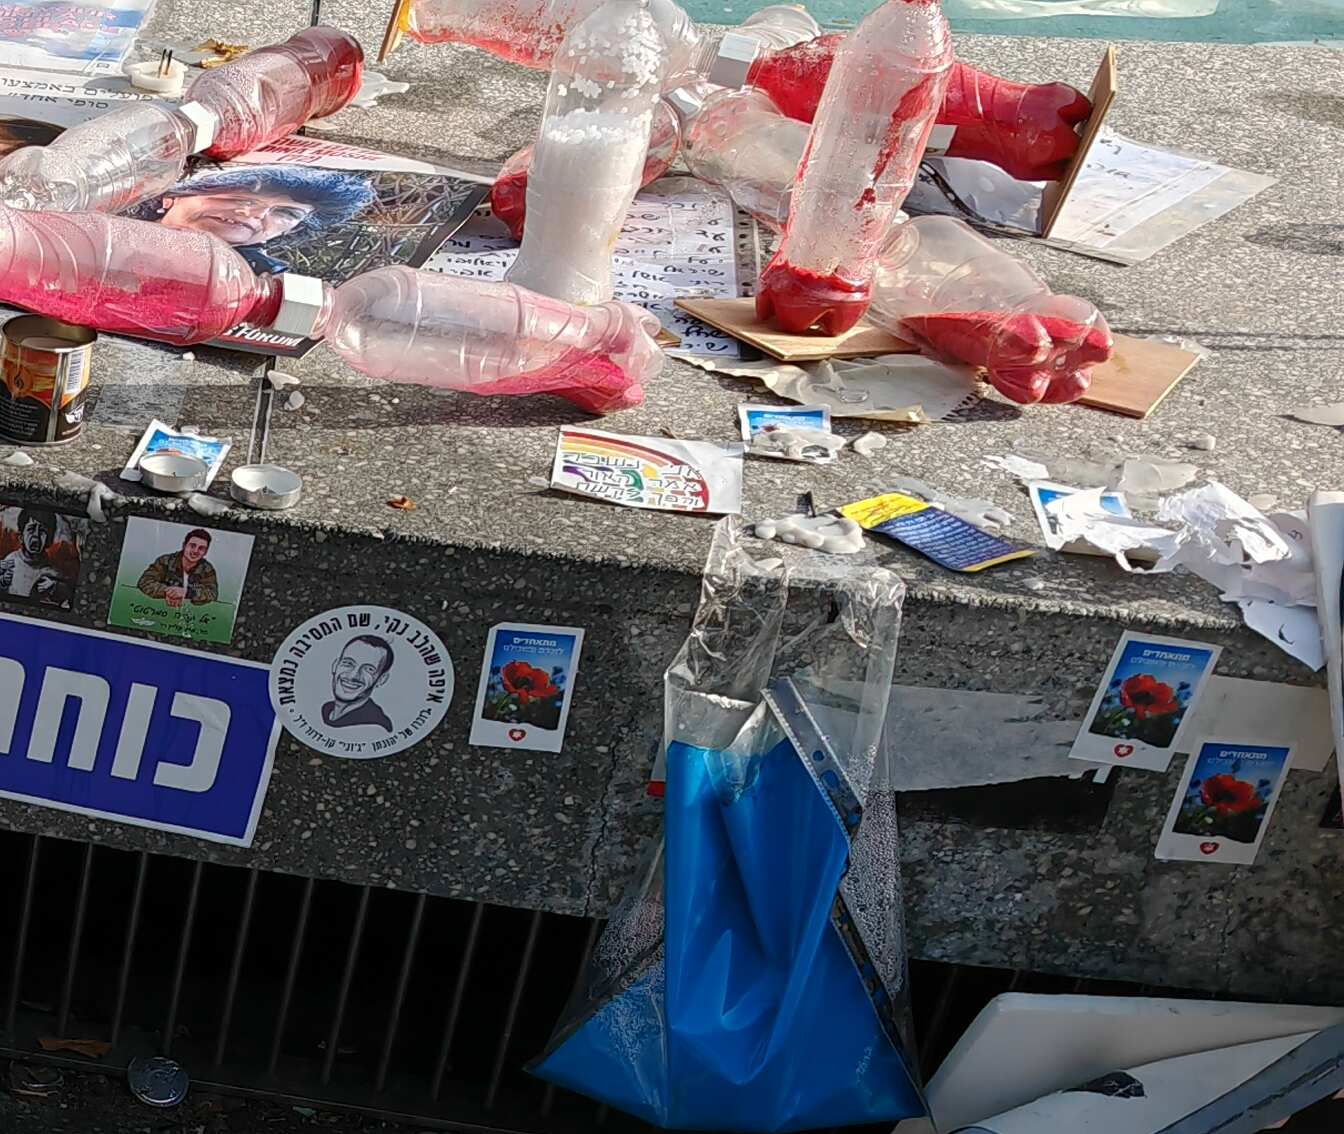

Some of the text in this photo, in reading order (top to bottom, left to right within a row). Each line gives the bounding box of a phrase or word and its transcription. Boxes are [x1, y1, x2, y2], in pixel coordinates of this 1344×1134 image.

[289, 617, 344, 659] המסיבה
[347, 613, 371, 628] שם
[407, 629, 442, 667] שהלב
[277, 659, 299, 705] נמצאת
[425, 668, 447, 704] איפה
